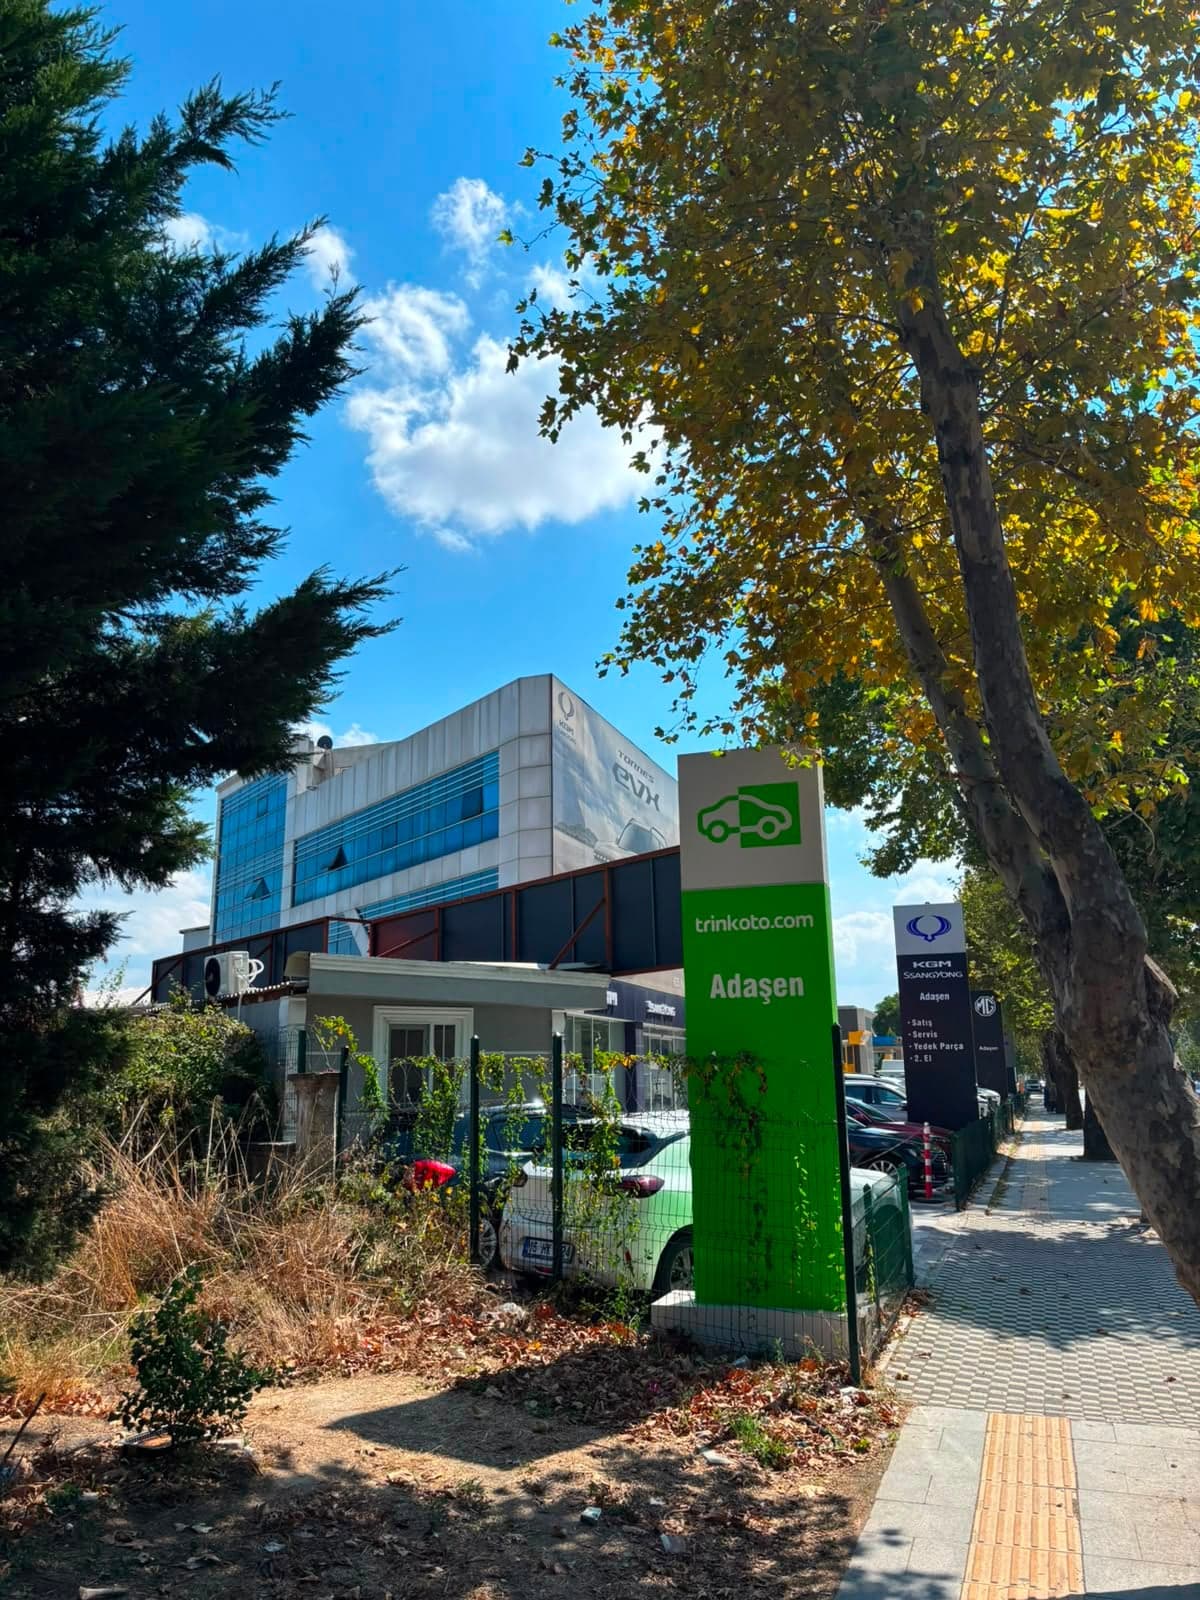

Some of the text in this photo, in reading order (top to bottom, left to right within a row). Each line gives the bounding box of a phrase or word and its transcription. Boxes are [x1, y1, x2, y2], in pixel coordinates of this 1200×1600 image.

[695, 913, 814, 933] trinkoto.com
[913, 960, 952, 968] KGM
[904, 971, 963, 979] SSANGYONG
[710, 973, 805, 1005] Adaşen
[920, 992, 950, 1002] Adaşen
[975, 995, 996, 1016] MG
[912, 1030, 938, 1039] Servis
[913, 1042, 964, 1051] Yedek Parça
